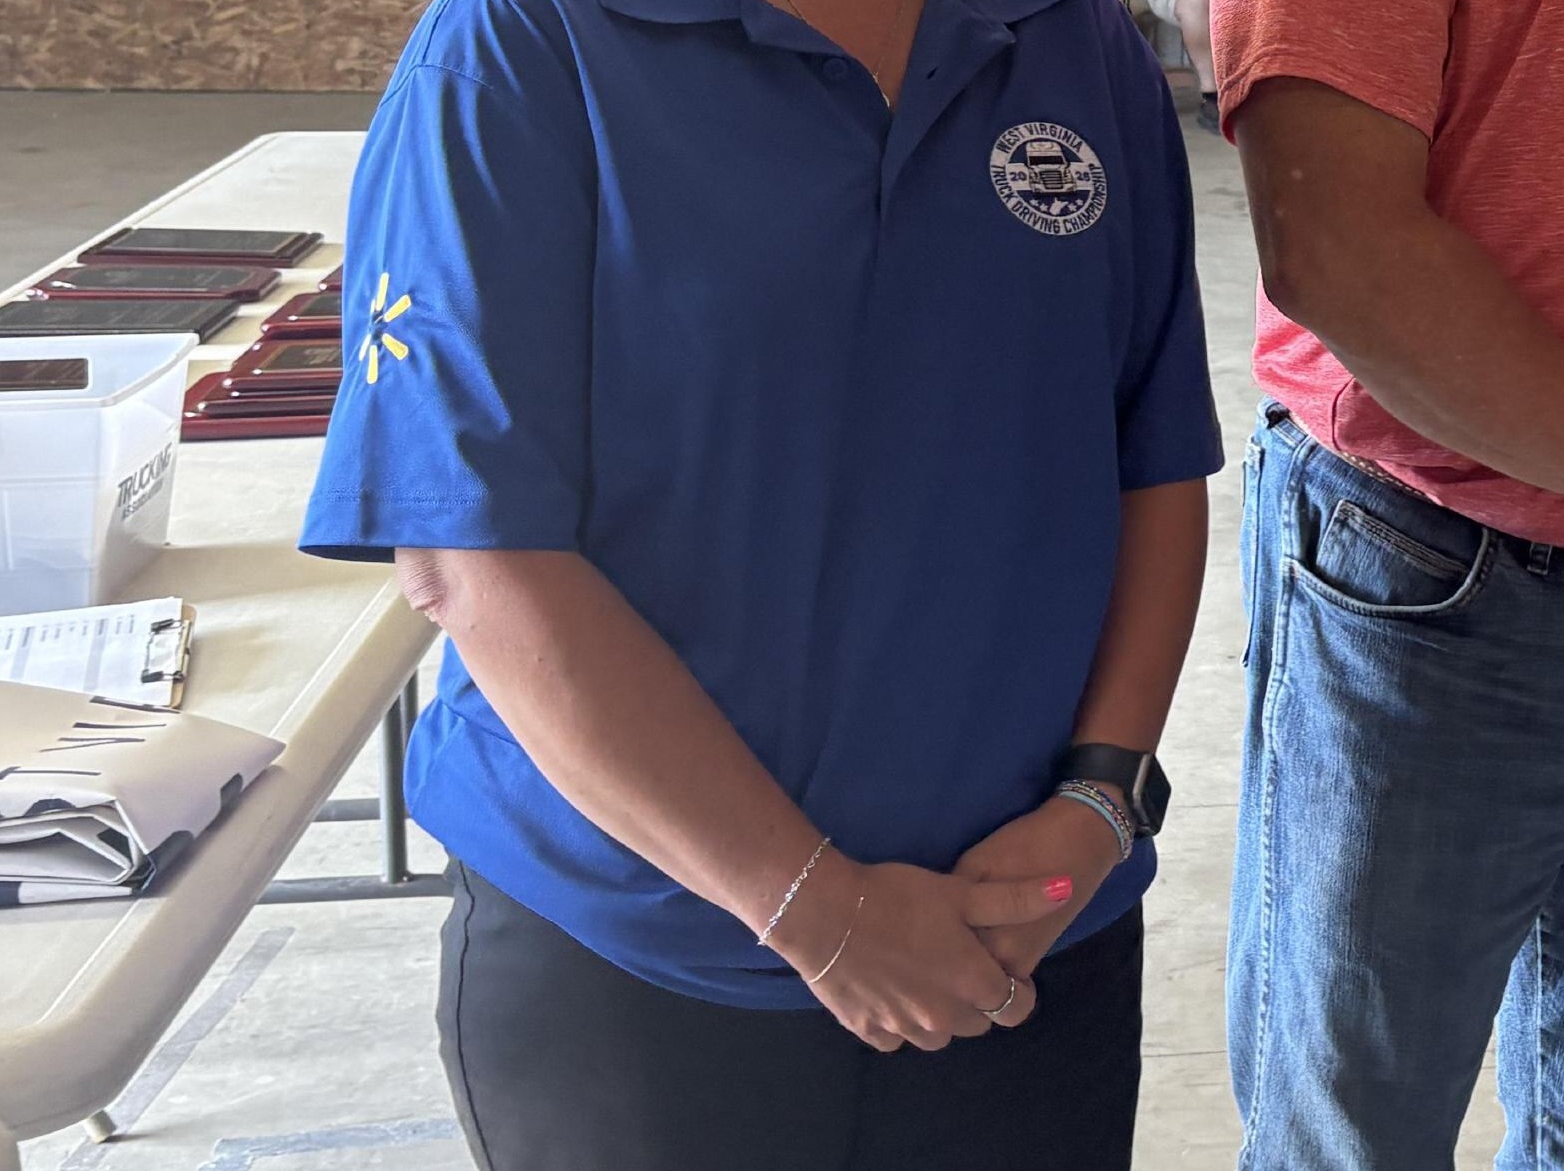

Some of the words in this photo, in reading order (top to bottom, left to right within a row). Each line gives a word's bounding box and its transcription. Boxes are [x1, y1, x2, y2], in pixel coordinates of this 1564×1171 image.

[996, 127, 1025, 154] WEST
[1024, 124, 1083, 153] VIRGINIA
[991, 165, 1015, 203] TRUCK
[1012, 202, 1061, 234] DRIVING
[1009, 171, 1027, 182] 20
[117, 441, 172, 508] TRUCKING
